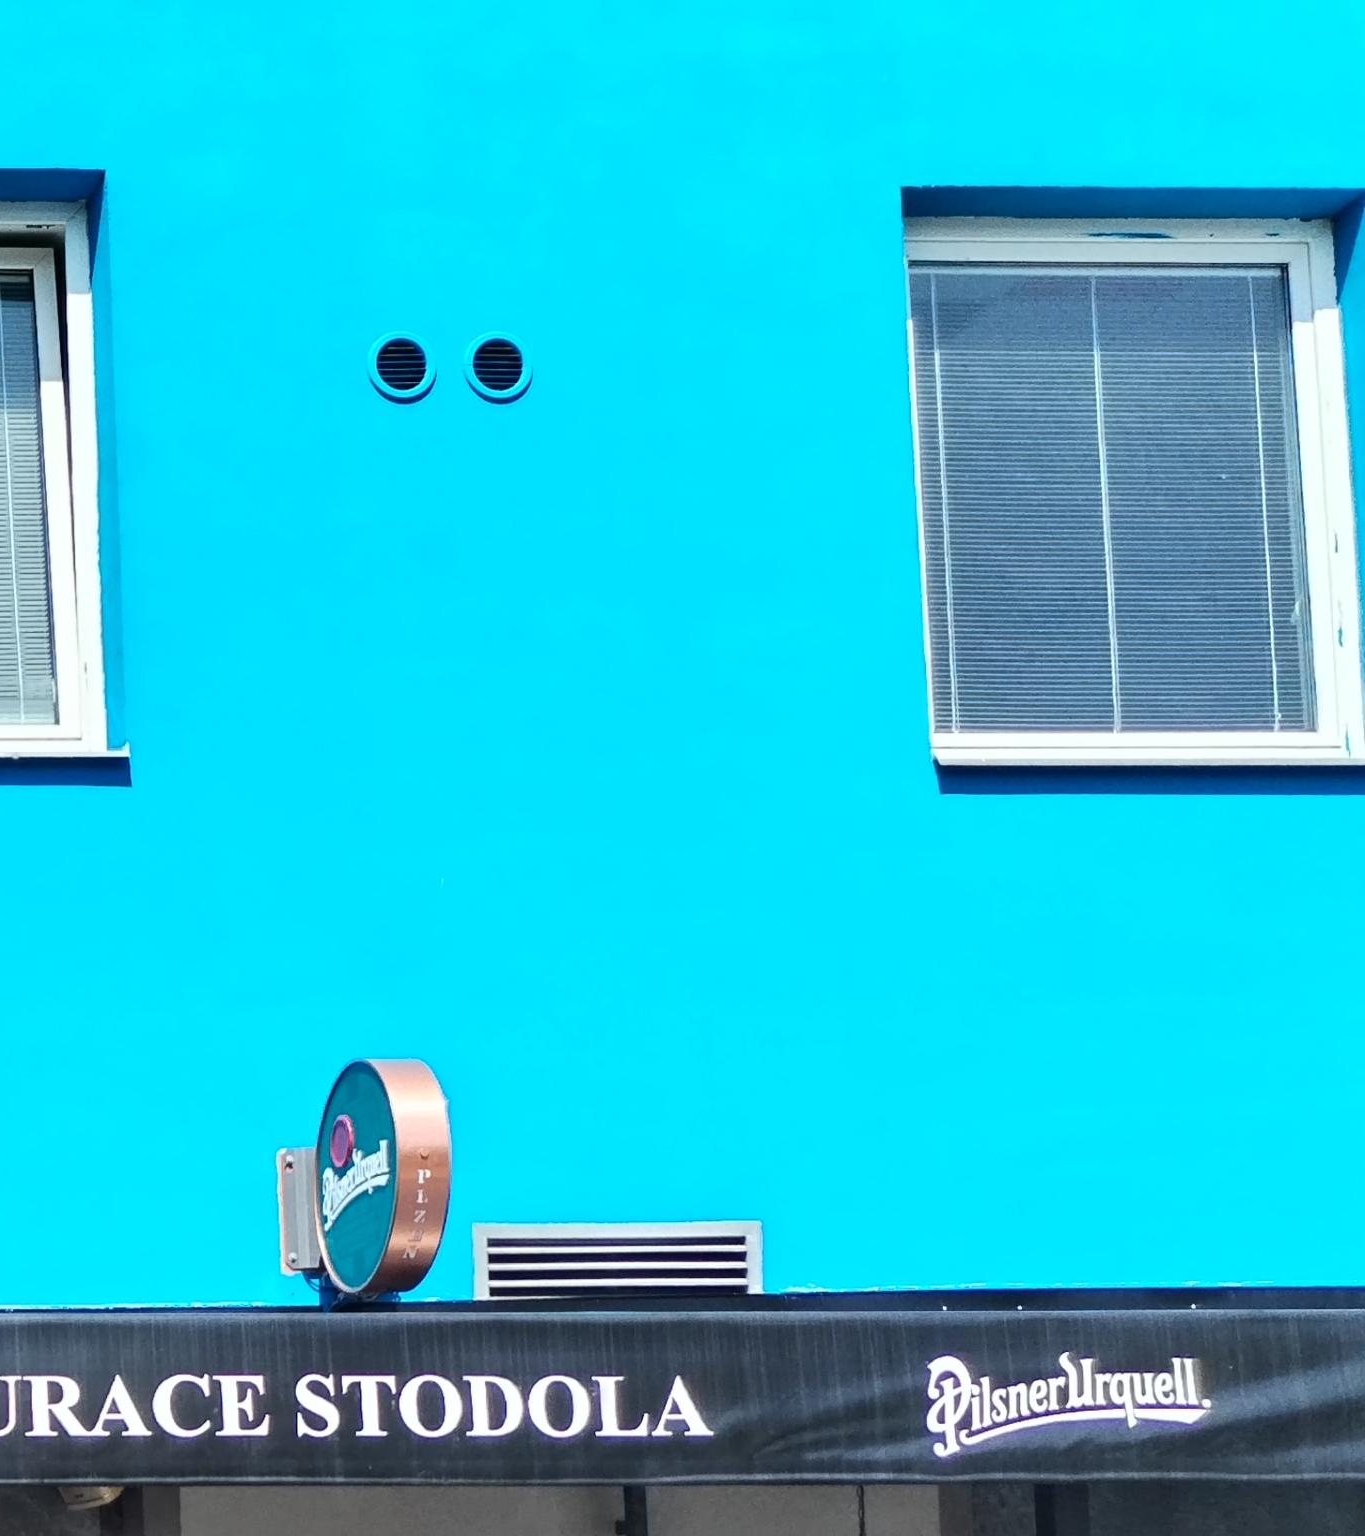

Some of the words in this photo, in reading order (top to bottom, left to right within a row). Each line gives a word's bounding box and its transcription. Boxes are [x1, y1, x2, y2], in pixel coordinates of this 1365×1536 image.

[295, 1374, 714, 1439] STODOLA
[926, 1355, 1067, 1458] Pilsner
[1059, 1352, 1203, 1428] Urquell
